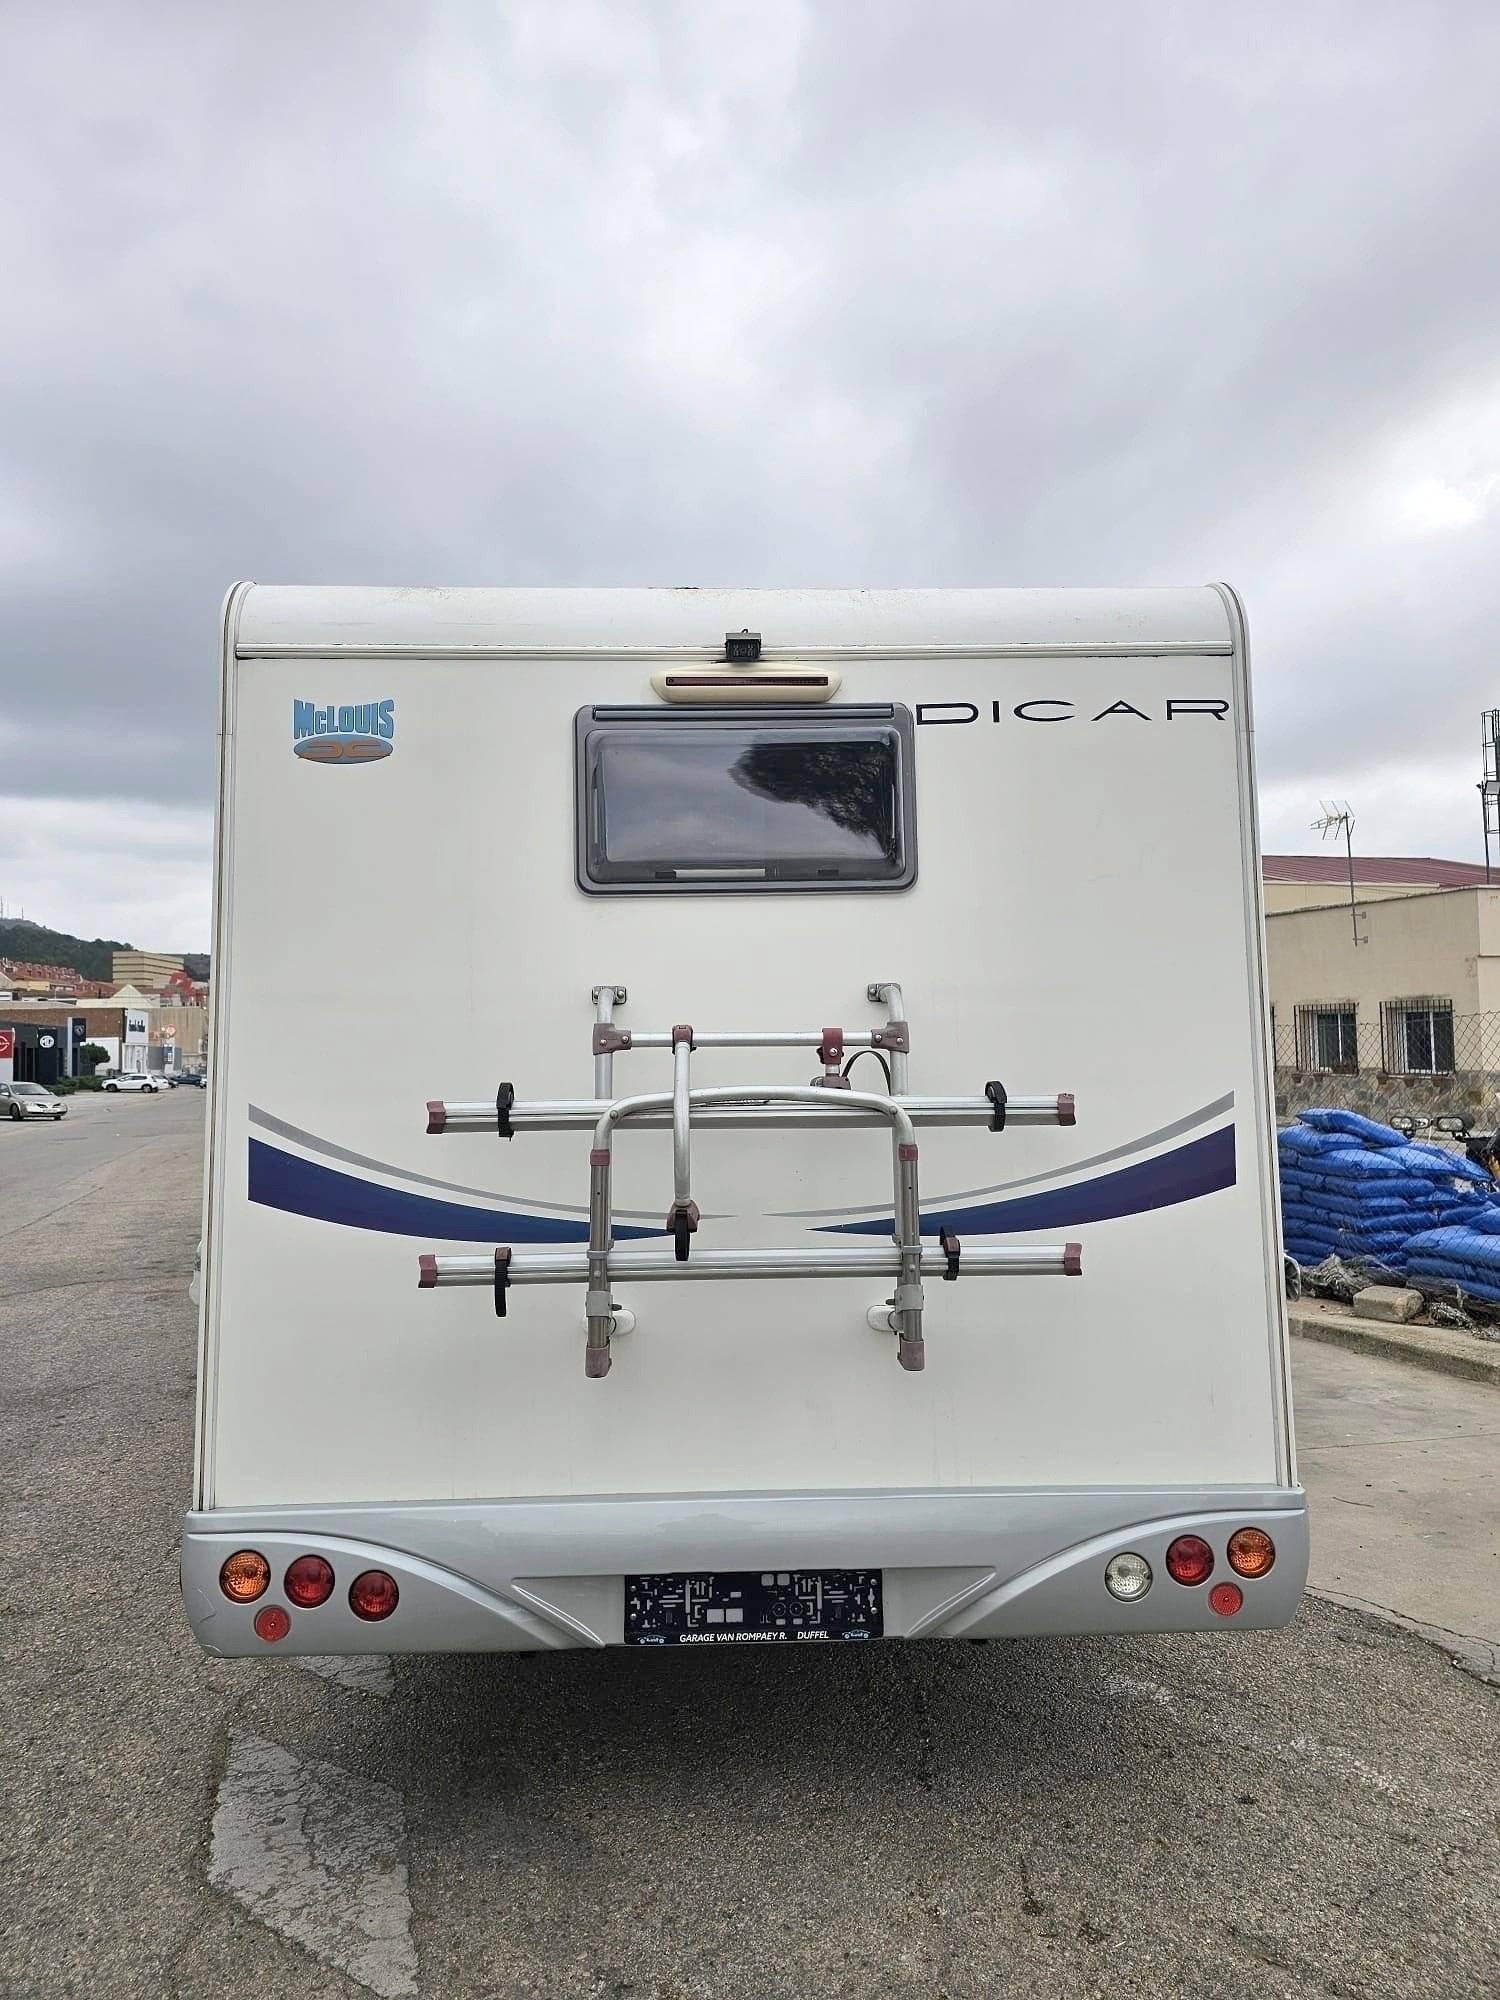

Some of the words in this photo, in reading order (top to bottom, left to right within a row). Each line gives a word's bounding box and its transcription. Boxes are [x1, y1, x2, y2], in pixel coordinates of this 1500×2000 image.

[915, 699, 1230, 725] DICAR
[679, 1633, 715, 1642] GARAGE
[716, 1632, 735, 1642] VAN
[736, 1632, 778, 1641] ROMPAEY
[779, 1631, 787, 1640] R.
[797, 1630, 829, 1639] DUFFEL
